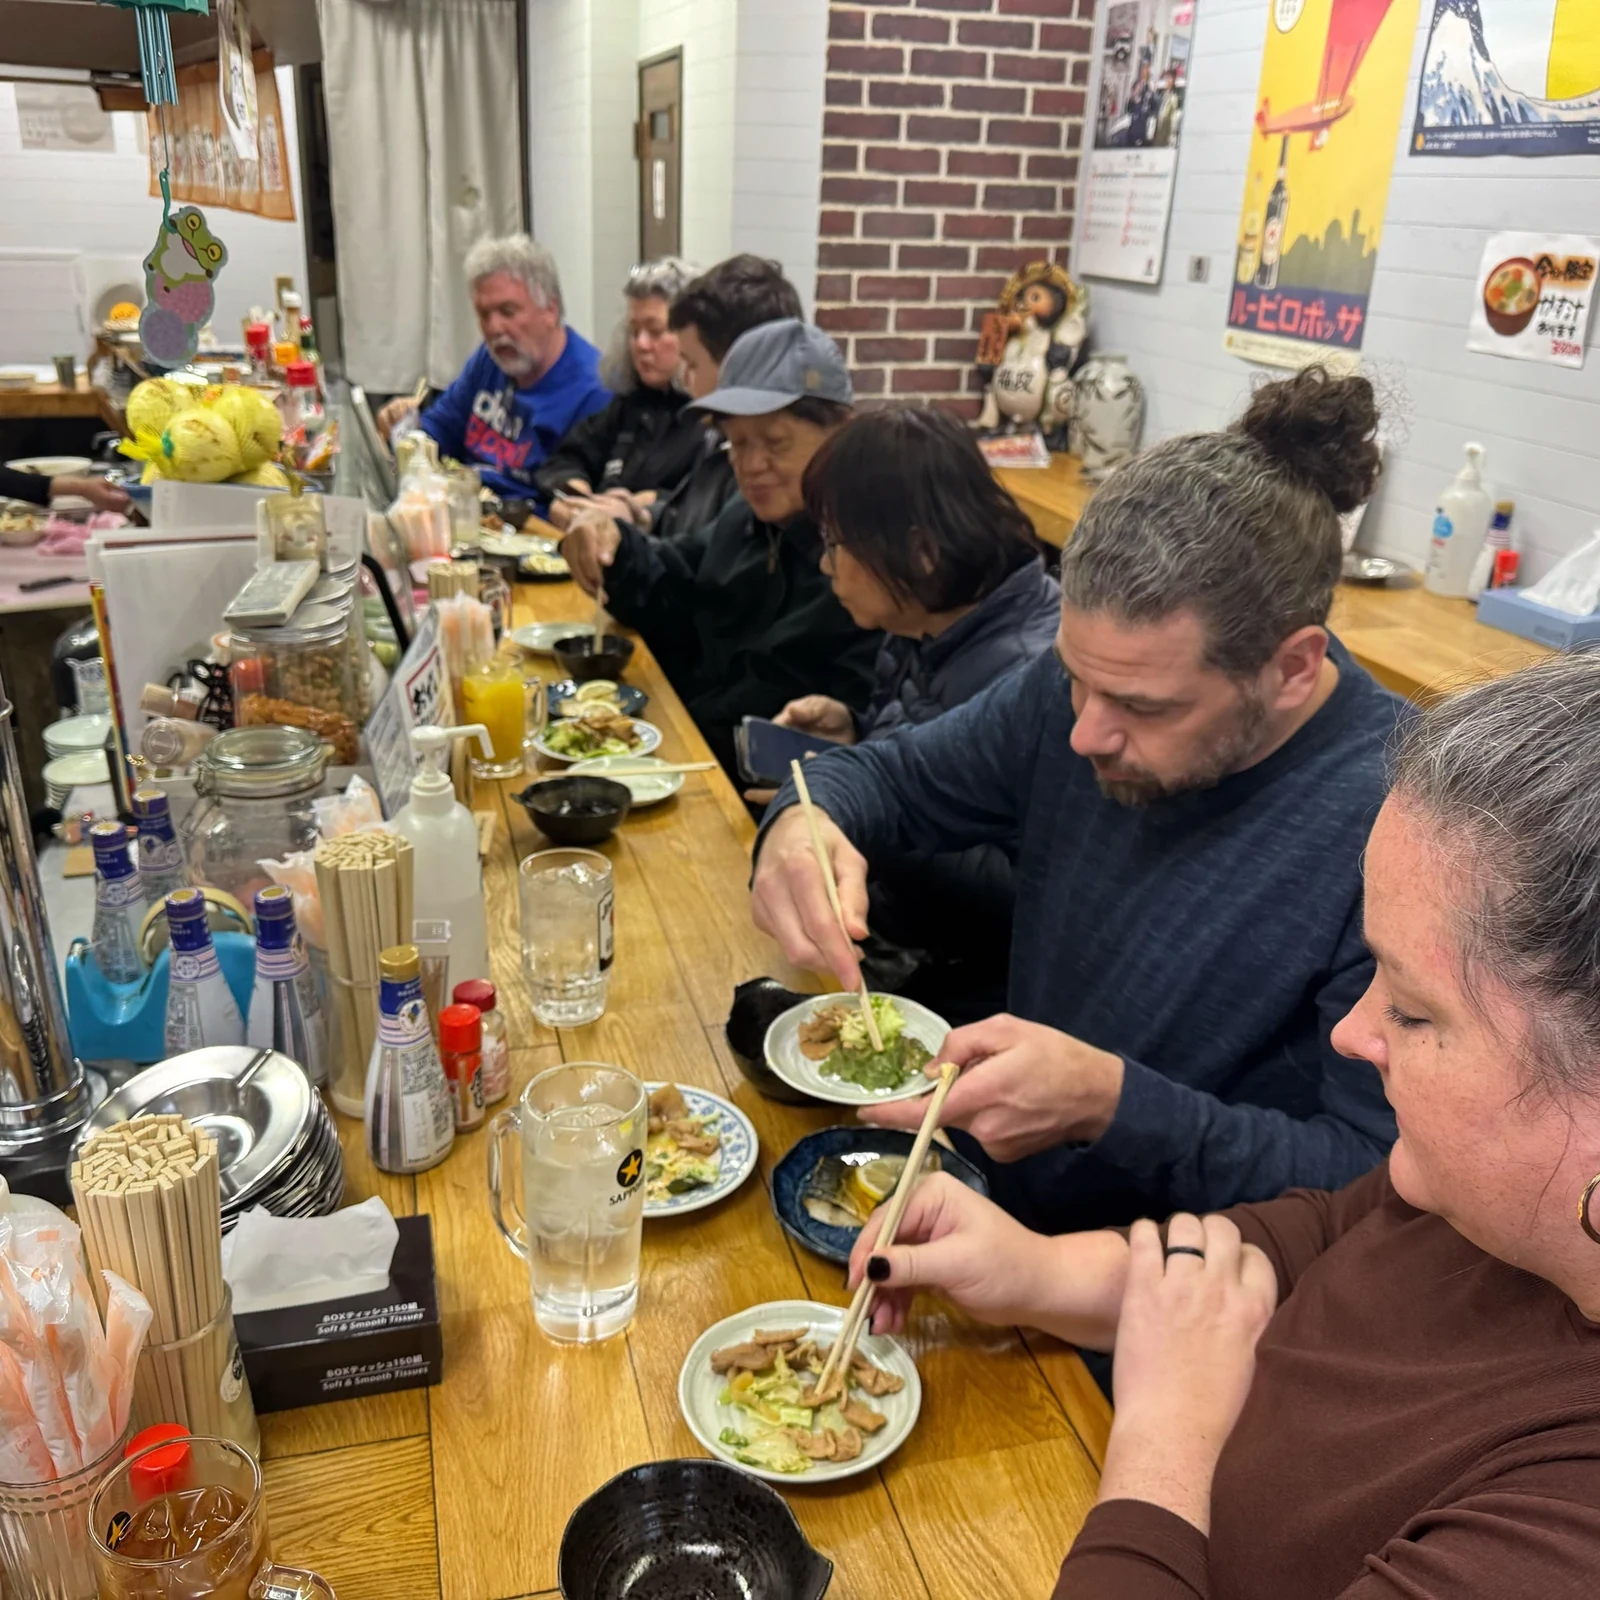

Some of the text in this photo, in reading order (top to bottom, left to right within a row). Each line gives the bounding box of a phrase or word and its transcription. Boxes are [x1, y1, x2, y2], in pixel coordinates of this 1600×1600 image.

[317, 1312, 424, 1335] Soft & Smooth Tissues
[322, 1366, 429, 1391] Soft & Smooth Tissues
